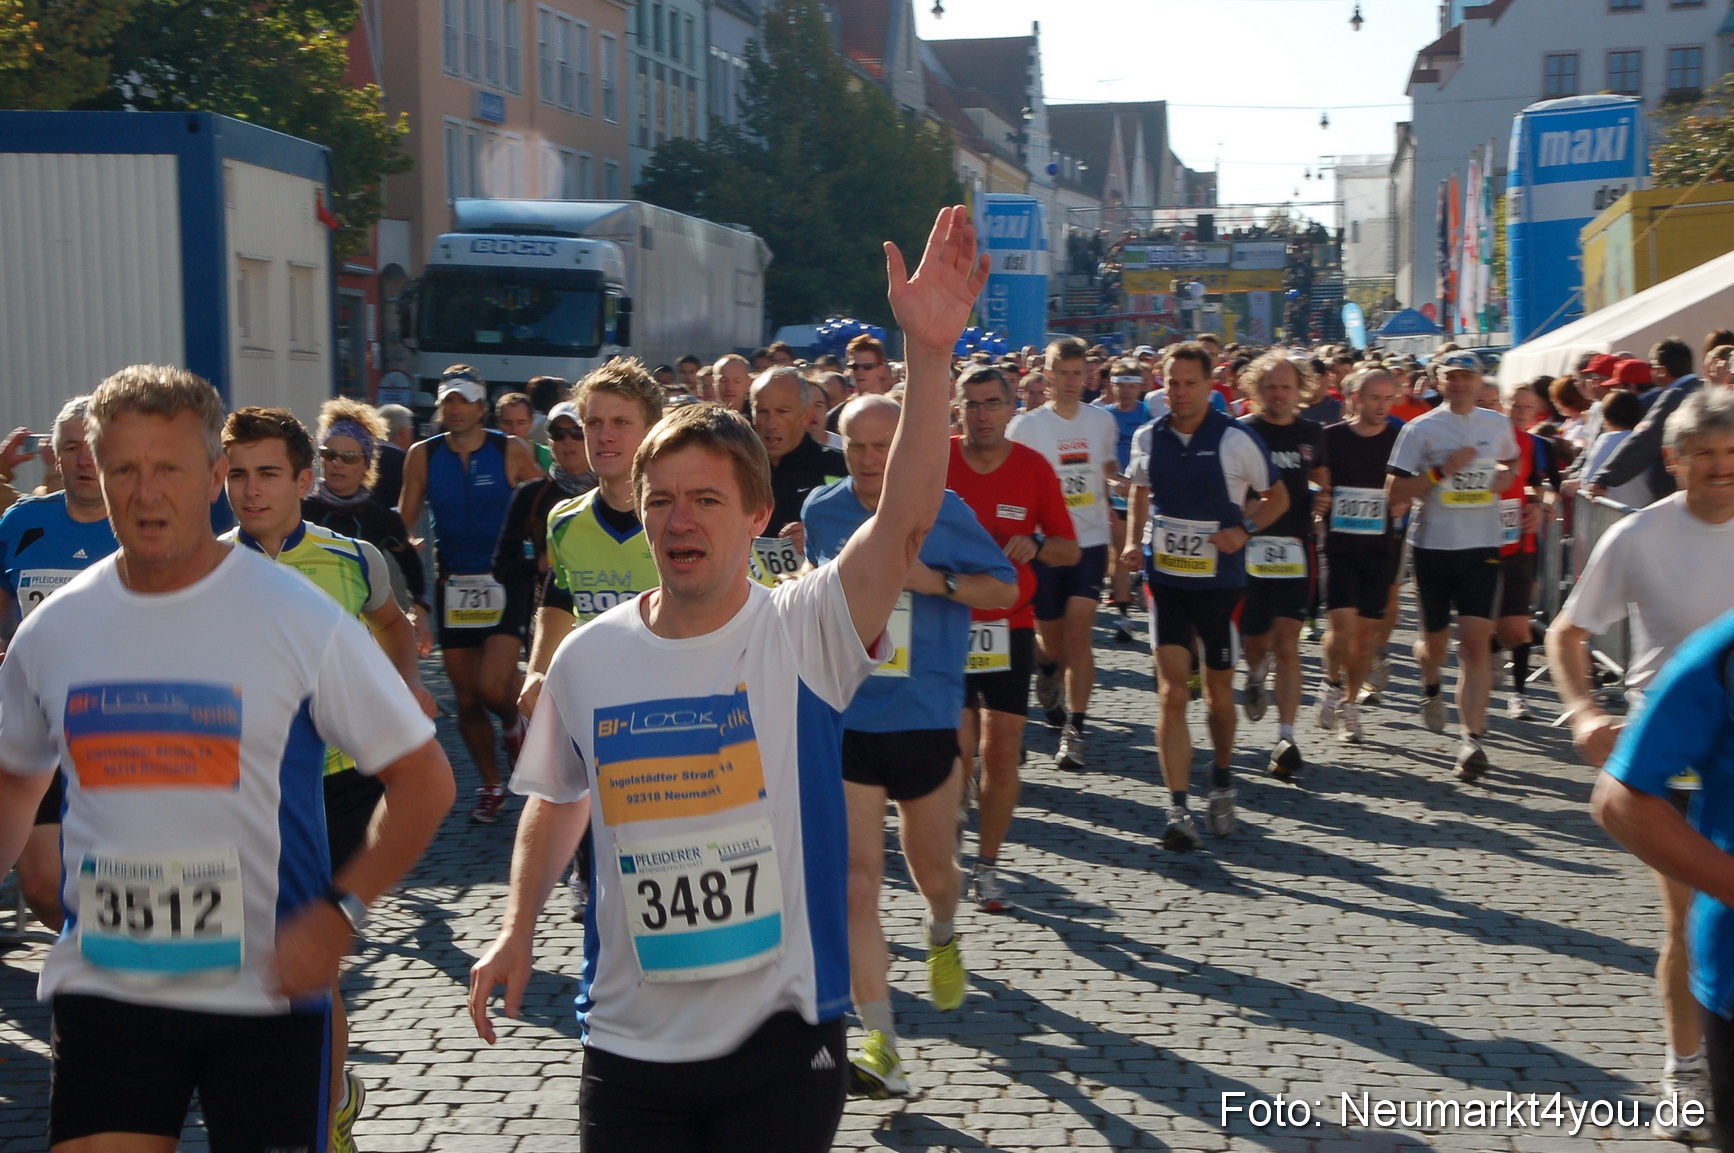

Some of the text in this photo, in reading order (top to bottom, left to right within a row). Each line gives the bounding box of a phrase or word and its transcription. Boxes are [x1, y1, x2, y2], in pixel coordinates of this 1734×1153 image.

[1537, 117, 1630, 168] maxi
[989, 211, 1031, 238] axi
[1164, 532, 1203, 557] 642
[571, 570, 632, 587] TEAM
[458, 588, 491, 609] 731
[610, 773, 678, 793] Ingolstädter
[682, 769, 717, 781] Straß
[626, 792, 662, 804] 92318
[635, 846, 702, 866] PFLEIDERER
[637, 861, 759, 931] 3487
[95, 882, 223, 938] 3512
